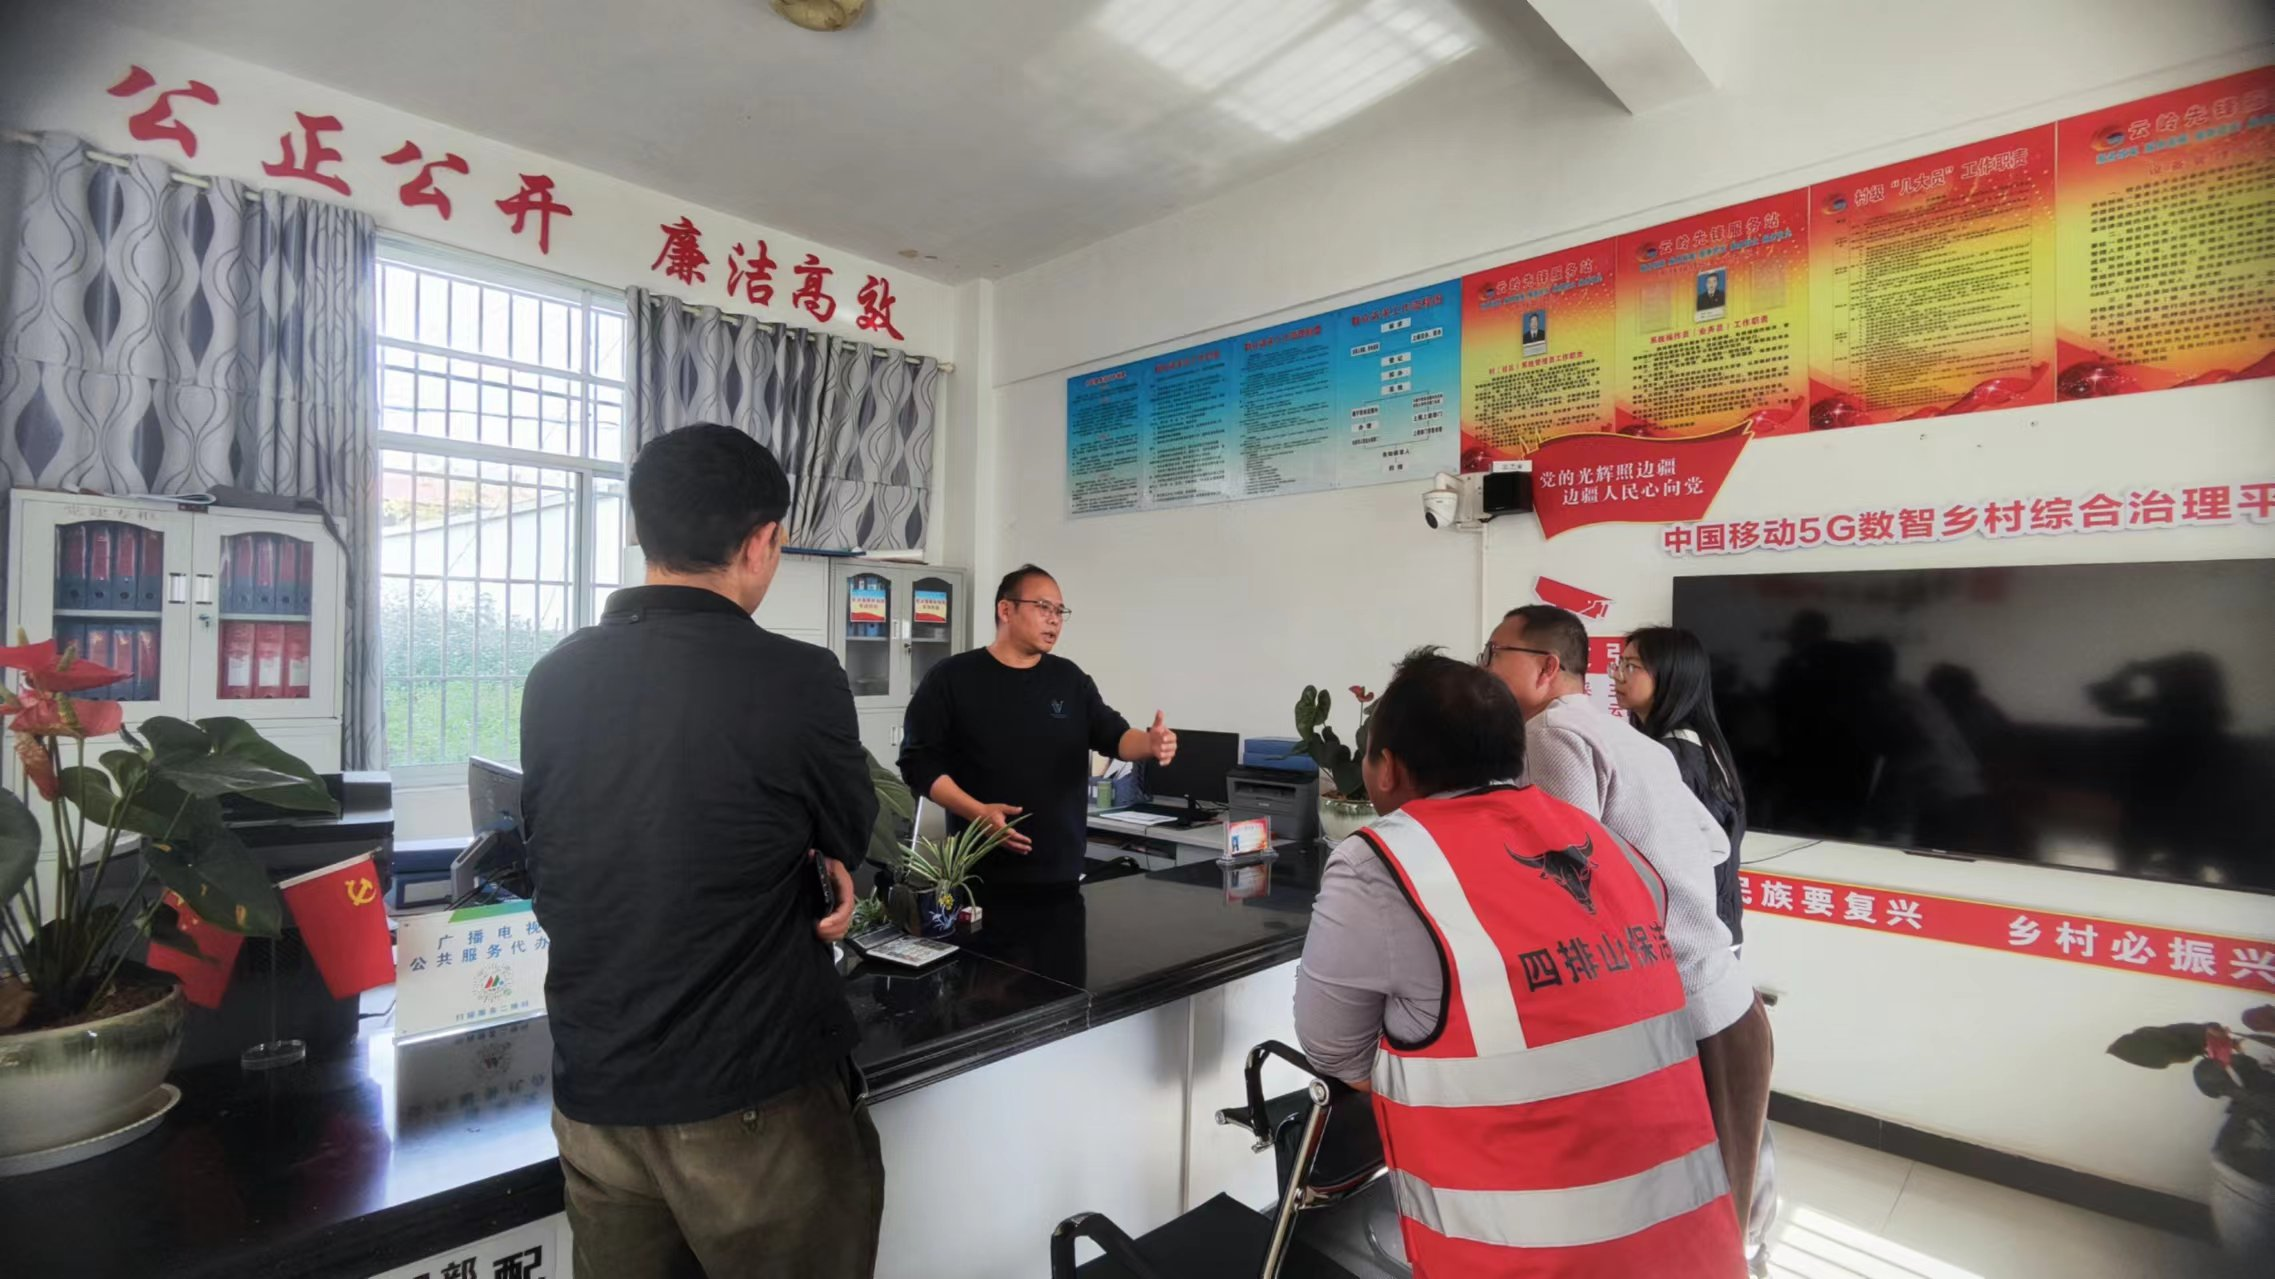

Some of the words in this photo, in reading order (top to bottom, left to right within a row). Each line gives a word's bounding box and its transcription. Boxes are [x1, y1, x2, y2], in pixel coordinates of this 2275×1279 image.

[1961, 148, 2029, 179] 工作职责
[107, 65, 573, 254] 公正公开
[651, 216, 905, 341] 廉洁高效
[1540, 458, 1676, 488] 党的光辉照边疆
[1562, 477, 1704, 505] 边疆人民心向党
[1664, 483, 2275, 553] 中国移动5G数智乡村综合治理平
[438, 921, 542, 950] 广播电视
[2008, 915, 2275, 983] 乡村必振兴
[410, 936, 550, 971] 公共服务代办
[413, 1245, 543, 1279] 部配
